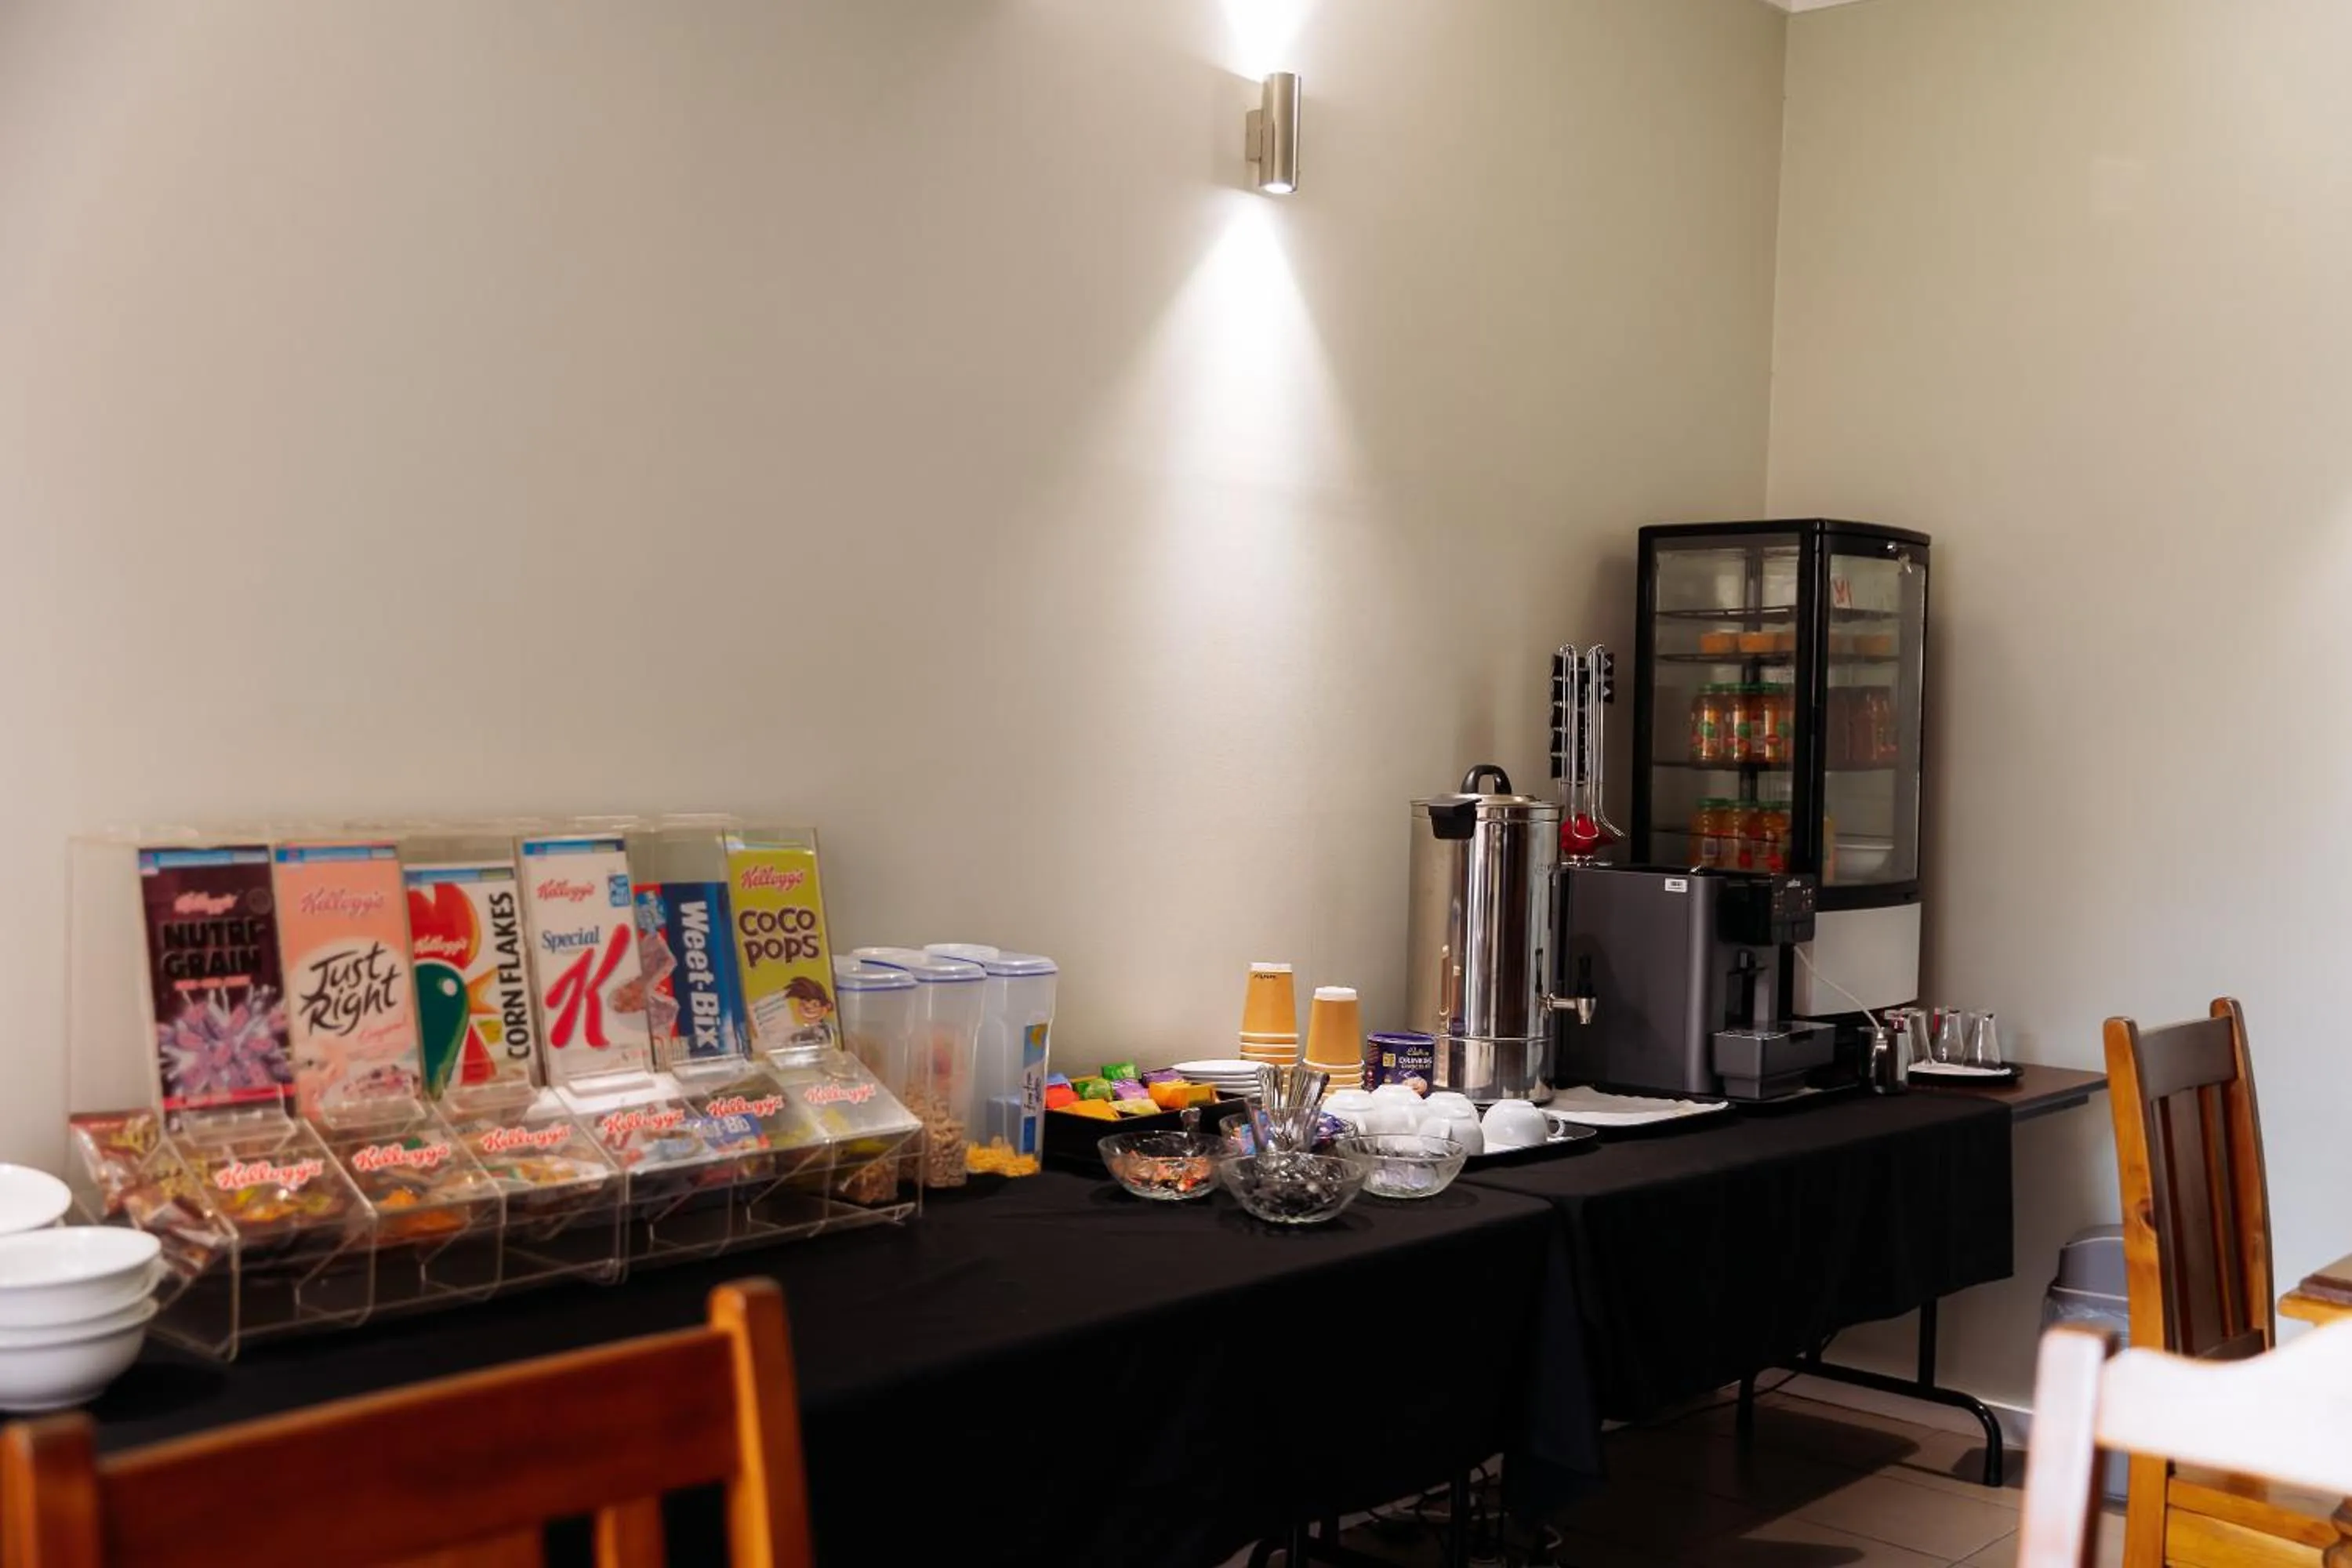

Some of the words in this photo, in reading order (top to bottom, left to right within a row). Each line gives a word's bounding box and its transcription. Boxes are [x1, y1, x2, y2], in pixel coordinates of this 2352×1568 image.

[161, 946, 261, 979] GRAIN
[309, 941, 386, 996] Just
[489, 891, 522, 985] FLAKES
[541, 925, 600, 953] Special
[298, 963, 402, 1036] Right
[544, 923, 631, 1048] K
[680, 901, 720, 1048] Weet-Bix
[501, 989, 531, 1059] CORN
